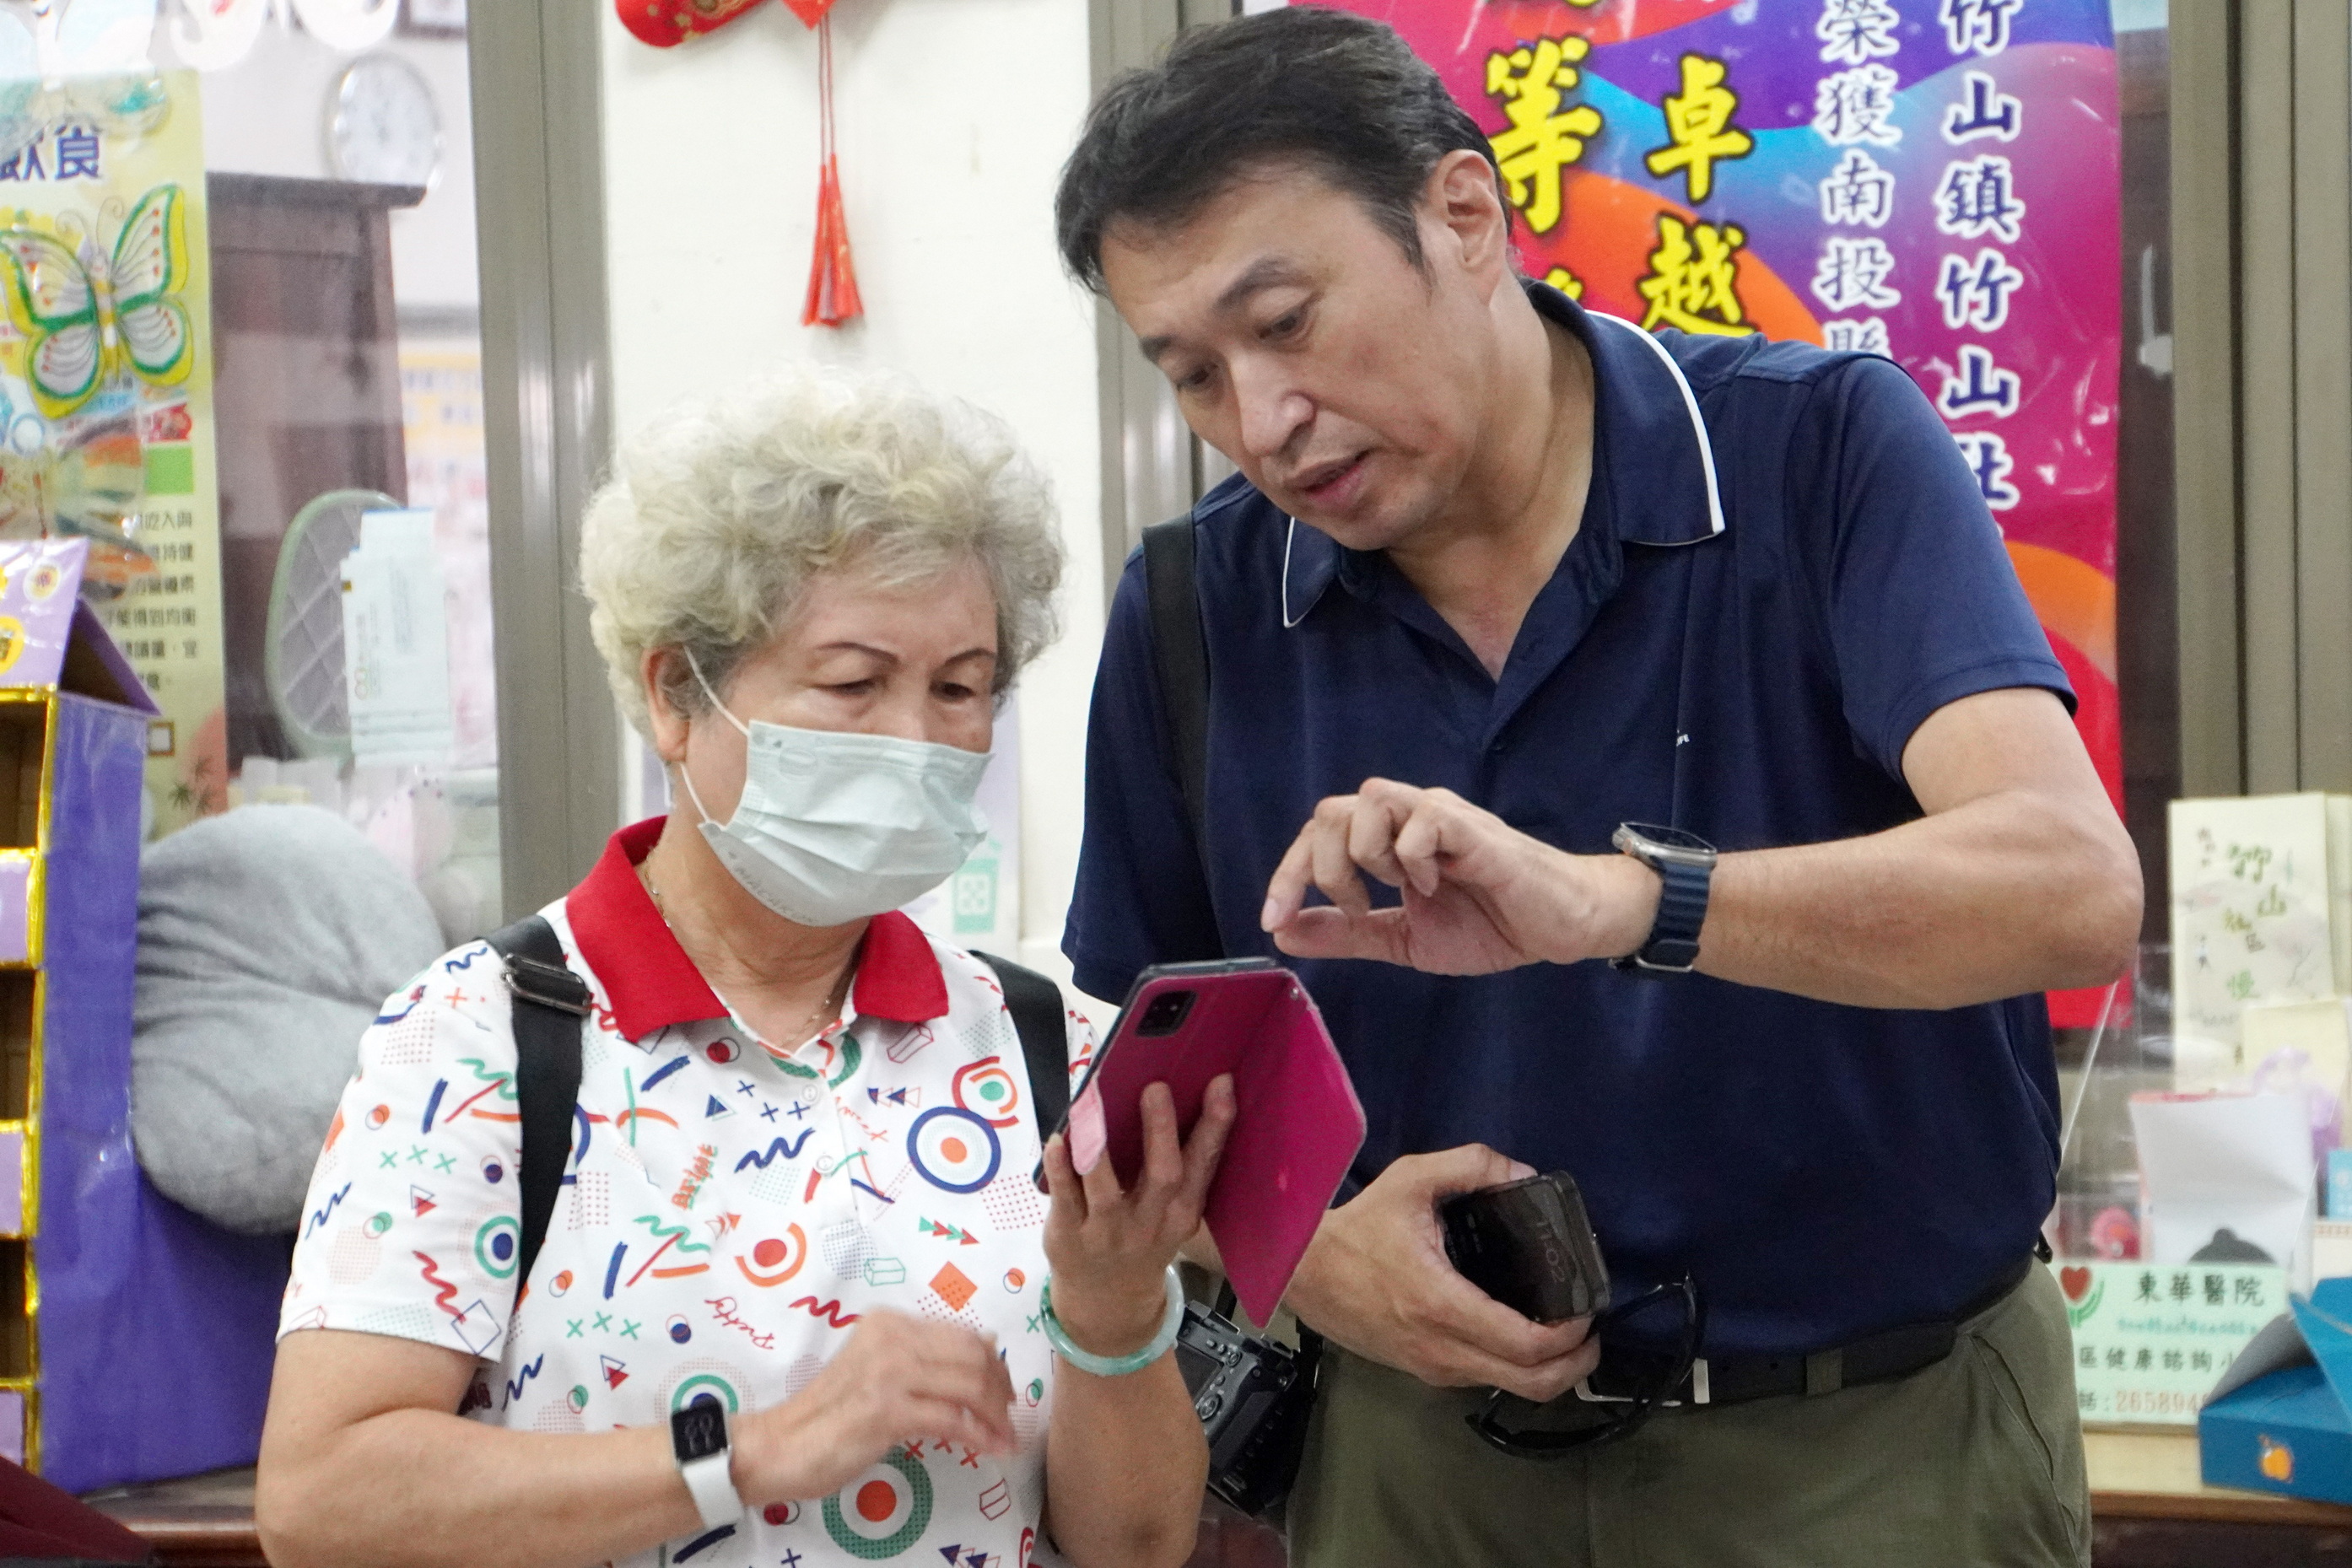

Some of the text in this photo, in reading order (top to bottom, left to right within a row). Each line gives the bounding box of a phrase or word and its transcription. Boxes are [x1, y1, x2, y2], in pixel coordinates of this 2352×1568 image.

[1481, 35, 1601, 300] 等
[1639, 53, 1756, 336] 卓越
[2134, 1270, 2265, 1307] 東華醫院
